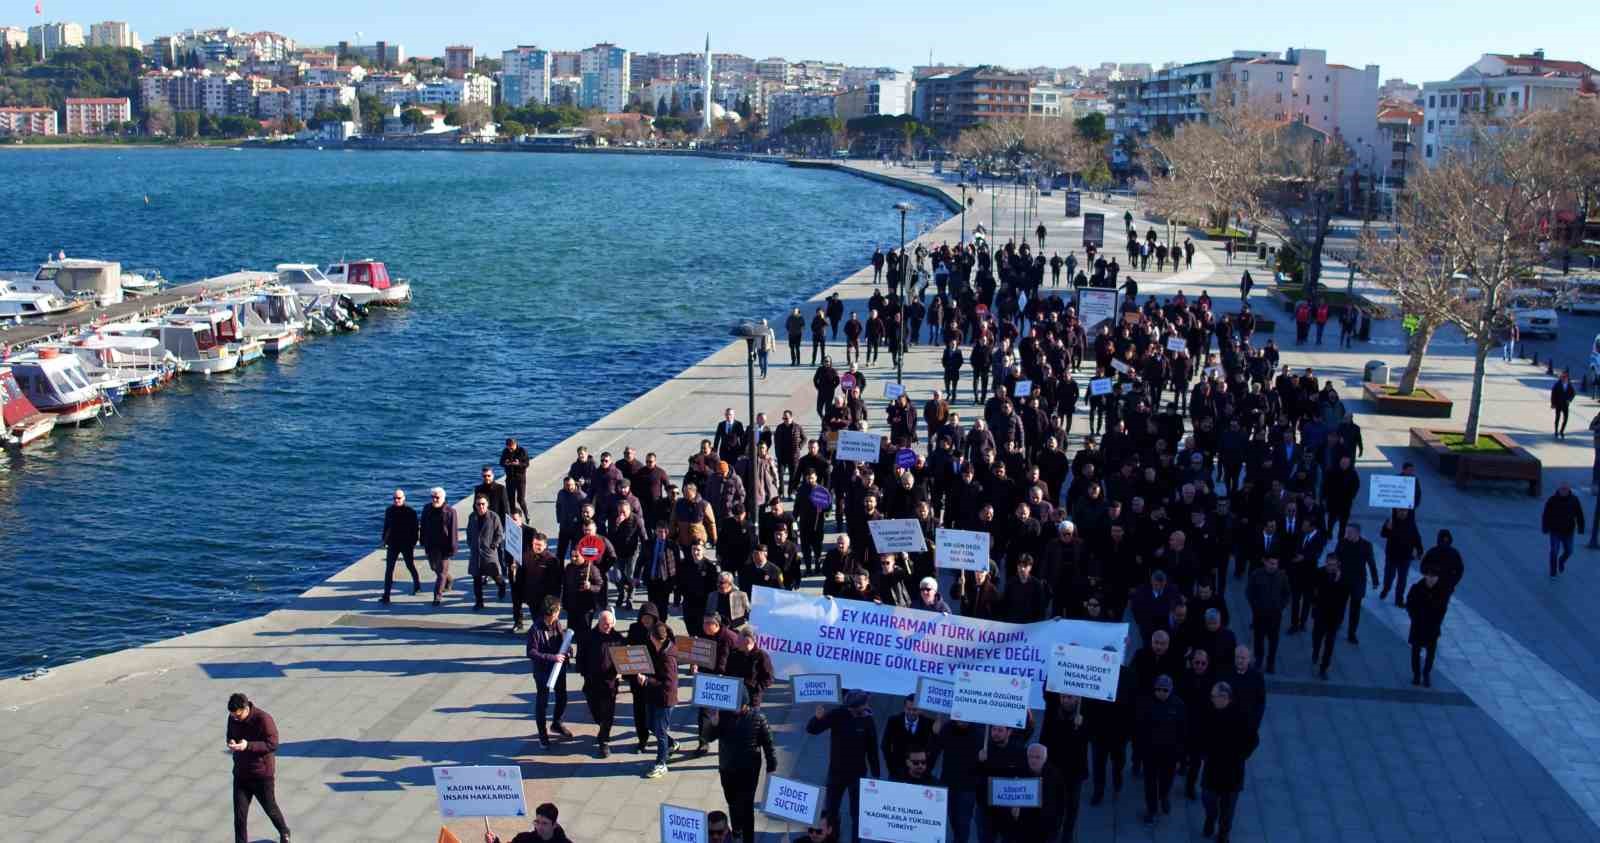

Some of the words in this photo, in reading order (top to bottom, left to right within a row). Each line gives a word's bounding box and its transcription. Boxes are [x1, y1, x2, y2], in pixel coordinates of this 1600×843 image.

[841, 609, 858, 622] EY
[861, 611, 937, 635] KAHRAMAN
[941, 623, 975, 641] TÜRK
[978, 629, 1028, 644] KADINI,
[819, 625, 845, 640] SEN
[849, 629, 892, 648] YERDE
[896, 635, 1000, 660] SÜRÜKLENMEYE
[1004, 645, 1046, 664] DEĞİL,
[816, 642, 881, 666] ÜZERİNDE
[885, 653, 944, 675] GÖKLERE
[1057, 661, 1085, 670] KADINA
[1086, 664, 1112, 674] ŞİDDET
[705, 682, 729, 692] ŞİDDET
[702, 691, 731, 703] SUÇTUR!
[954, 695, 977, 705] DÜNYA
[960, 688, 992, 698] KADINLAR
[993, 690, 1023, 701] ÖZGÜRSE
[447, 784, 474, 792] KADIN
[475, 784, 512, 792] HAKLARI,
[778, 785, 809, 801] ŞİDDET
[443, 792, 469, 801] İNSAN
[774, 797, 809, 816] SUÇTUR!
[881, 803, 896, 812] AİLE
[668, 813, 701, 830] ŞİDDETE
